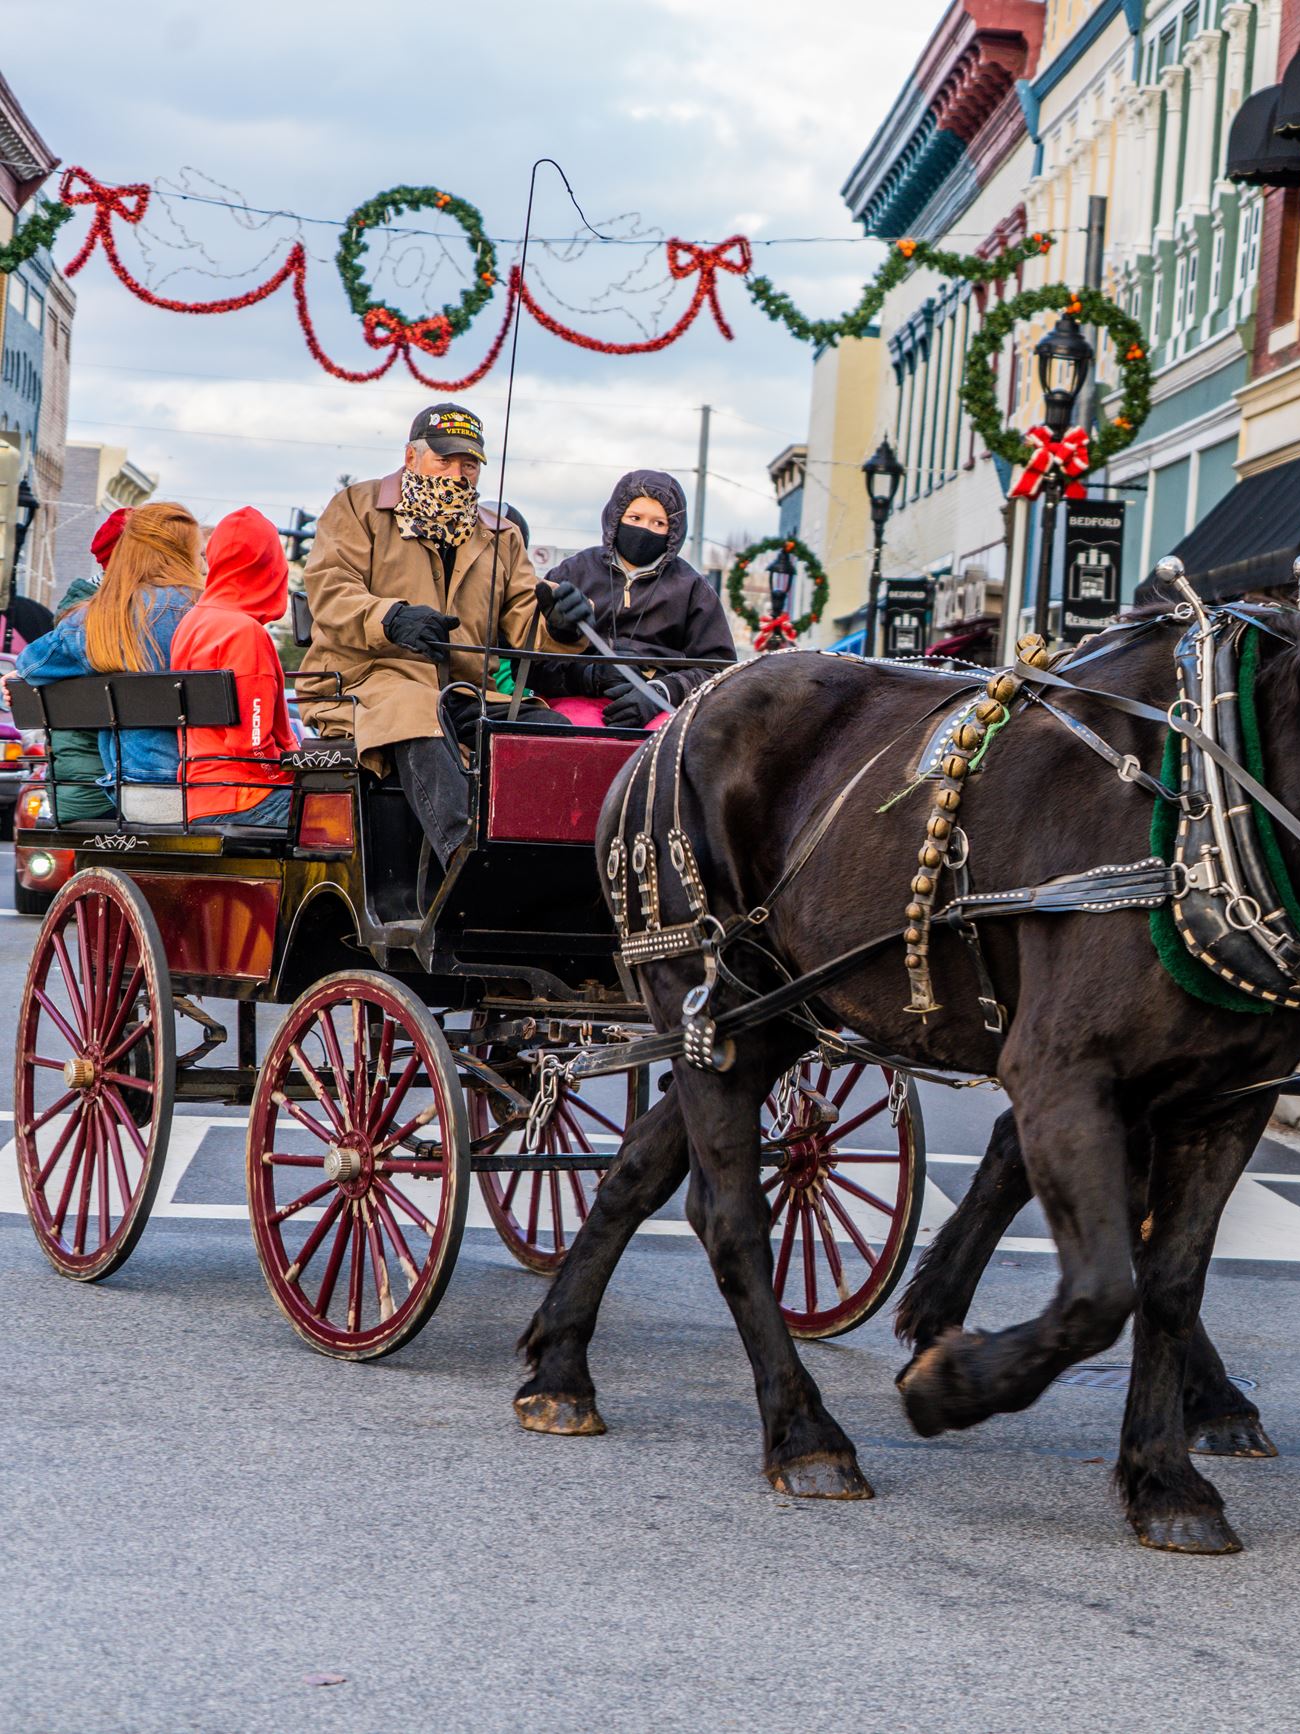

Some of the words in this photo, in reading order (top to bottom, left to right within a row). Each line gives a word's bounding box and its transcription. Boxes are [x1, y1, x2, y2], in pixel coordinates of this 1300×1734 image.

[446, 428, 477, 438] VETERAN
[1069, 516, 1121, 527] BEDFORD
[252, 698, 261, 747] UNDER
